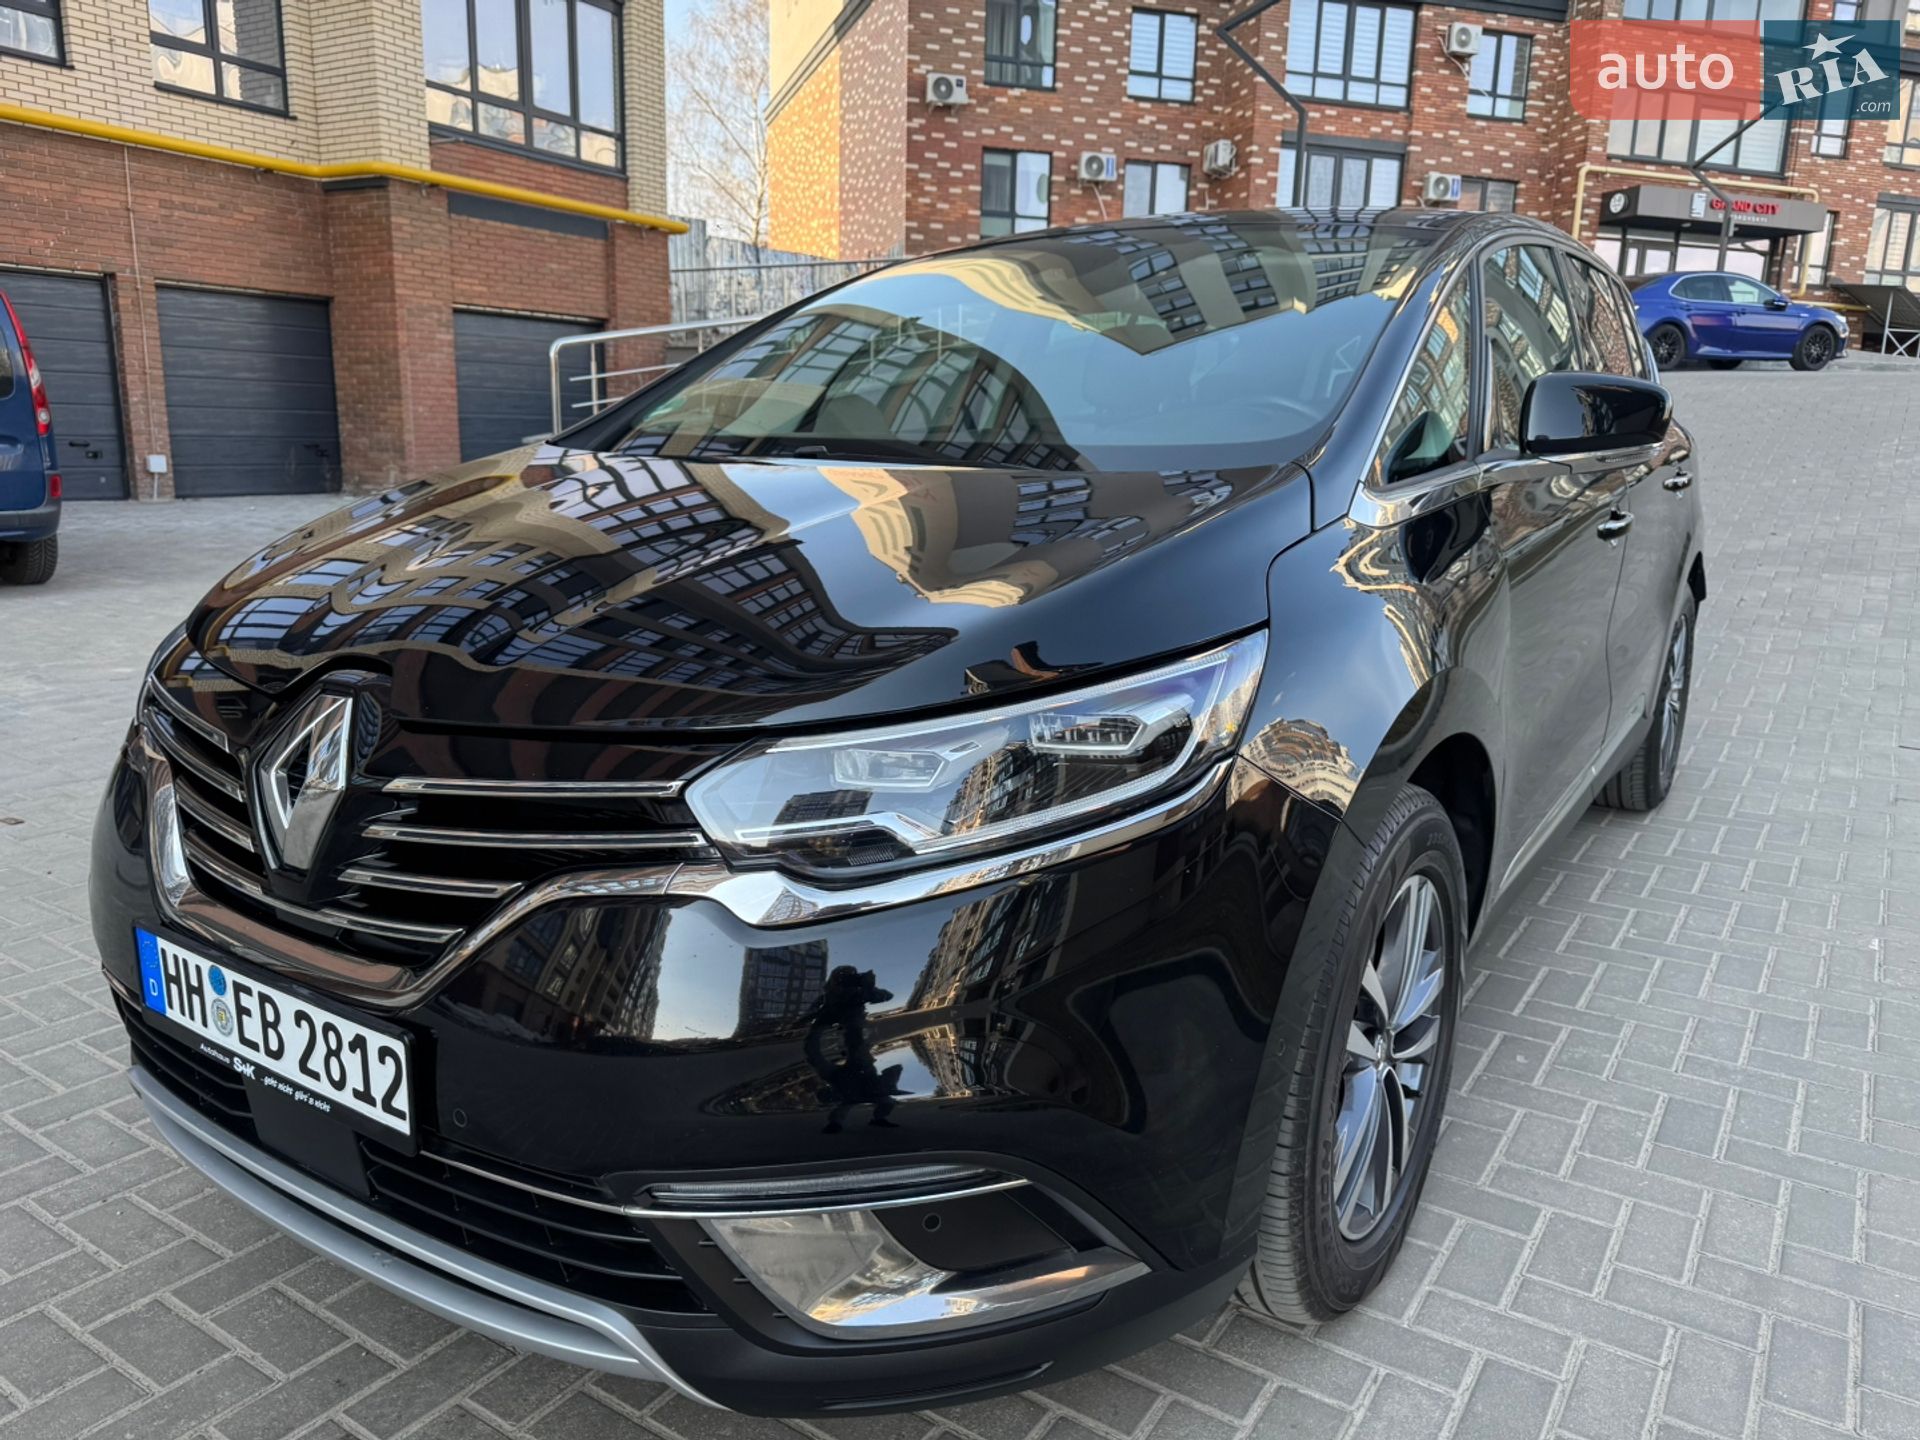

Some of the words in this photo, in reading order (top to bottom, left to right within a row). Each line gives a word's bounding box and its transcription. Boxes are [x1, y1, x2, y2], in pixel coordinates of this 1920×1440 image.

[1755, 202, 1781, 215] CITY
[148, 977, 159, 997] D
[160, 947, 208, 1029] HH
[232, 980, 285, 1061] EB
[294, 1009, 407, 1122] 2812
